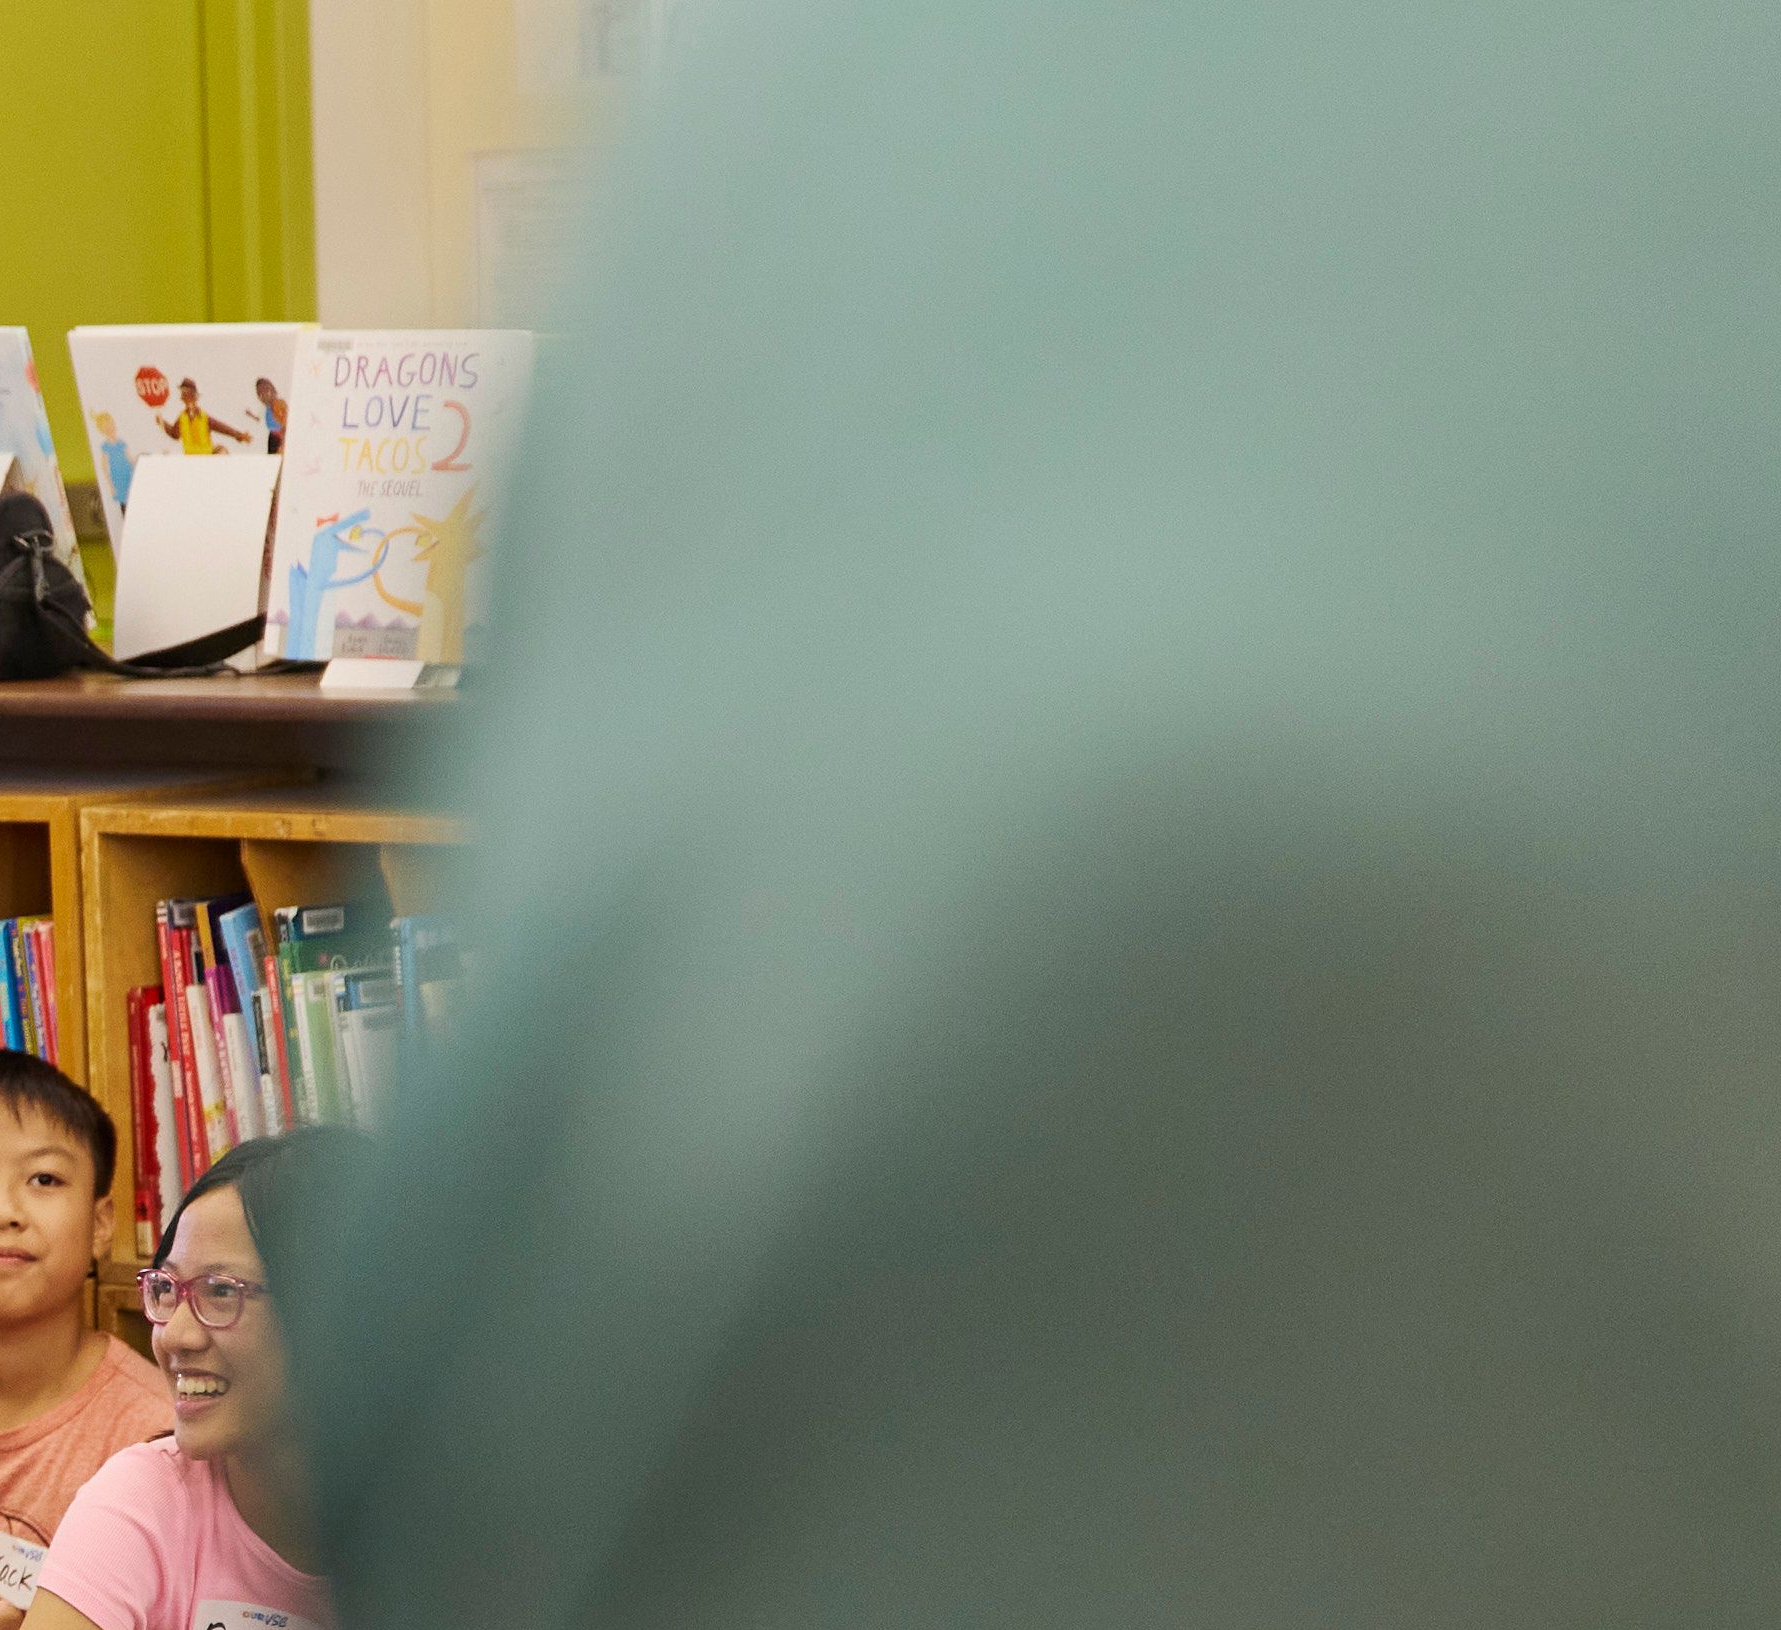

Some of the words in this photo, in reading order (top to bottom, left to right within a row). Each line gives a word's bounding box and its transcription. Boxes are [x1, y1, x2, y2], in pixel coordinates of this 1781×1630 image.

[333, 352, 480, 389] DRAGONS
[341, 394, 433, 431] LOVE
[339, 436, 428, 474] TACOS
[431, 400, 473, 472] 2
